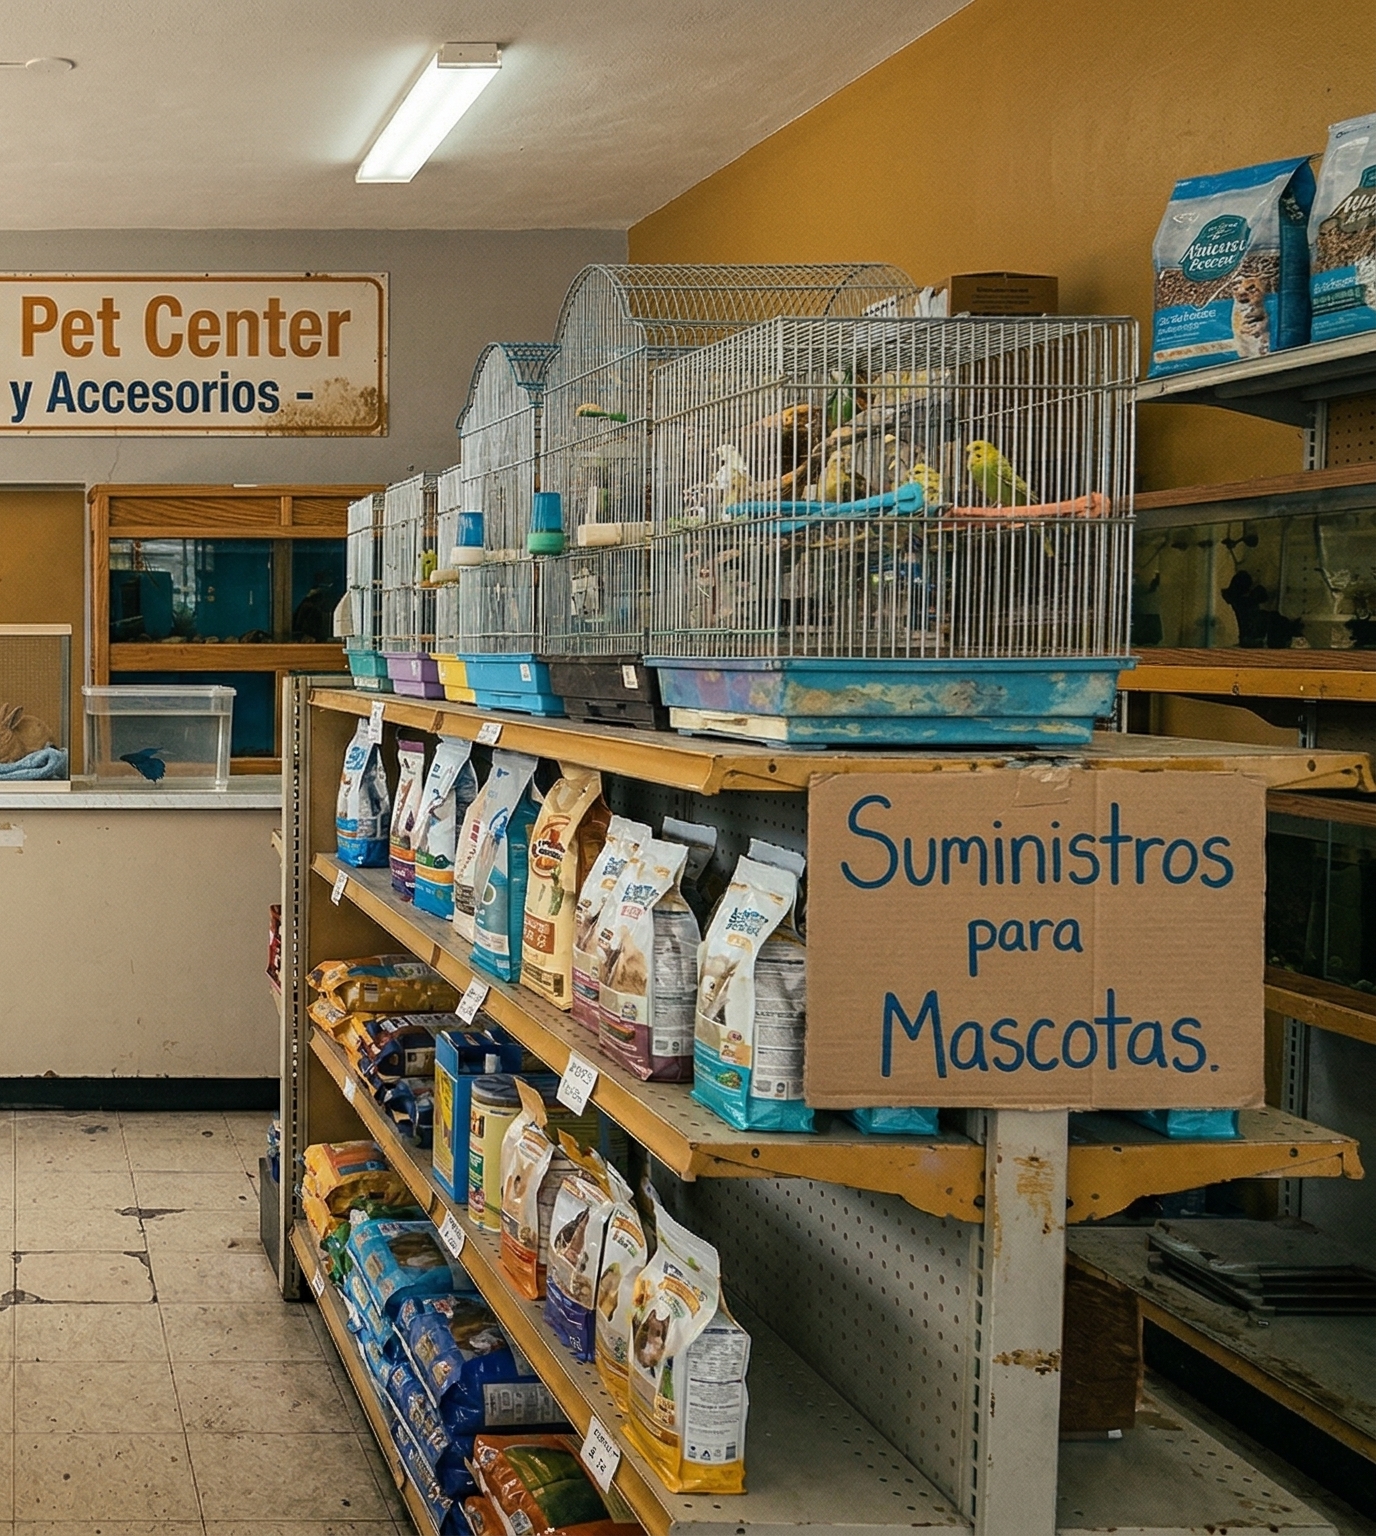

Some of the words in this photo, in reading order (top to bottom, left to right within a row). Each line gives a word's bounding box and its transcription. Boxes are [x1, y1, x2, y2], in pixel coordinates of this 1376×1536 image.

[21, 296, 121, 358] Pet
[144, 294, 352, 358] Center
[10, 379, 32, 423] y
[45, 370, 281, 414] Accesorios
[840, 793, 1236, 890] Suministros
[967, 918, 1084, 978] para
[880, 987, 1220, 1080] Mascotas.
